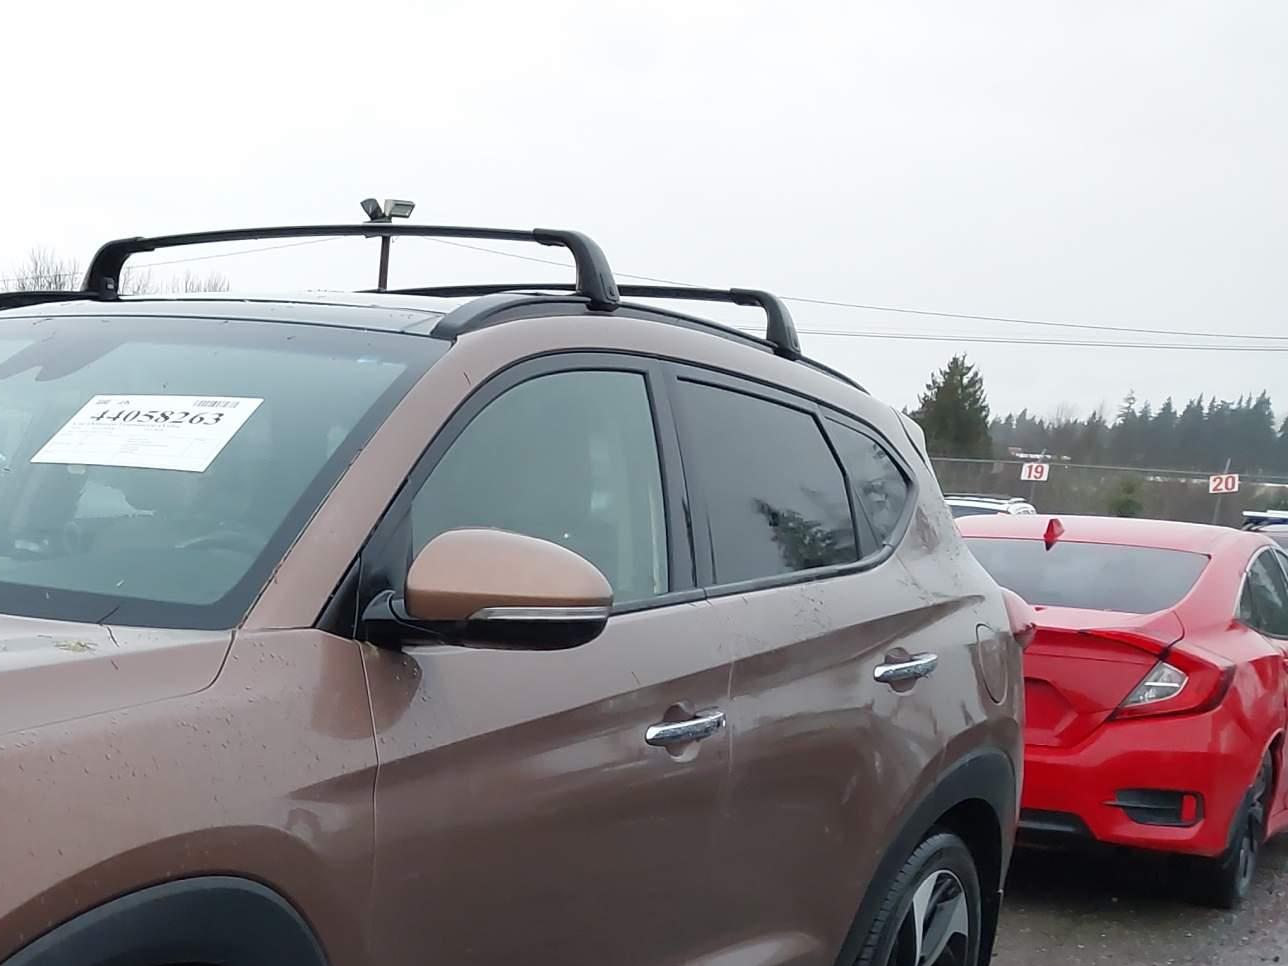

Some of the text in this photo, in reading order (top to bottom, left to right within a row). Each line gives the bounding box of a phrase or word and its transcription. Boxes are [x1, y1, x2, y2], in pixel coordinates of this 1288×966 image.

[90, 409, 225, 425] 44058263
[1025, 463, 1045, 480] 19
[1212, 475, 1237, 492] 20
